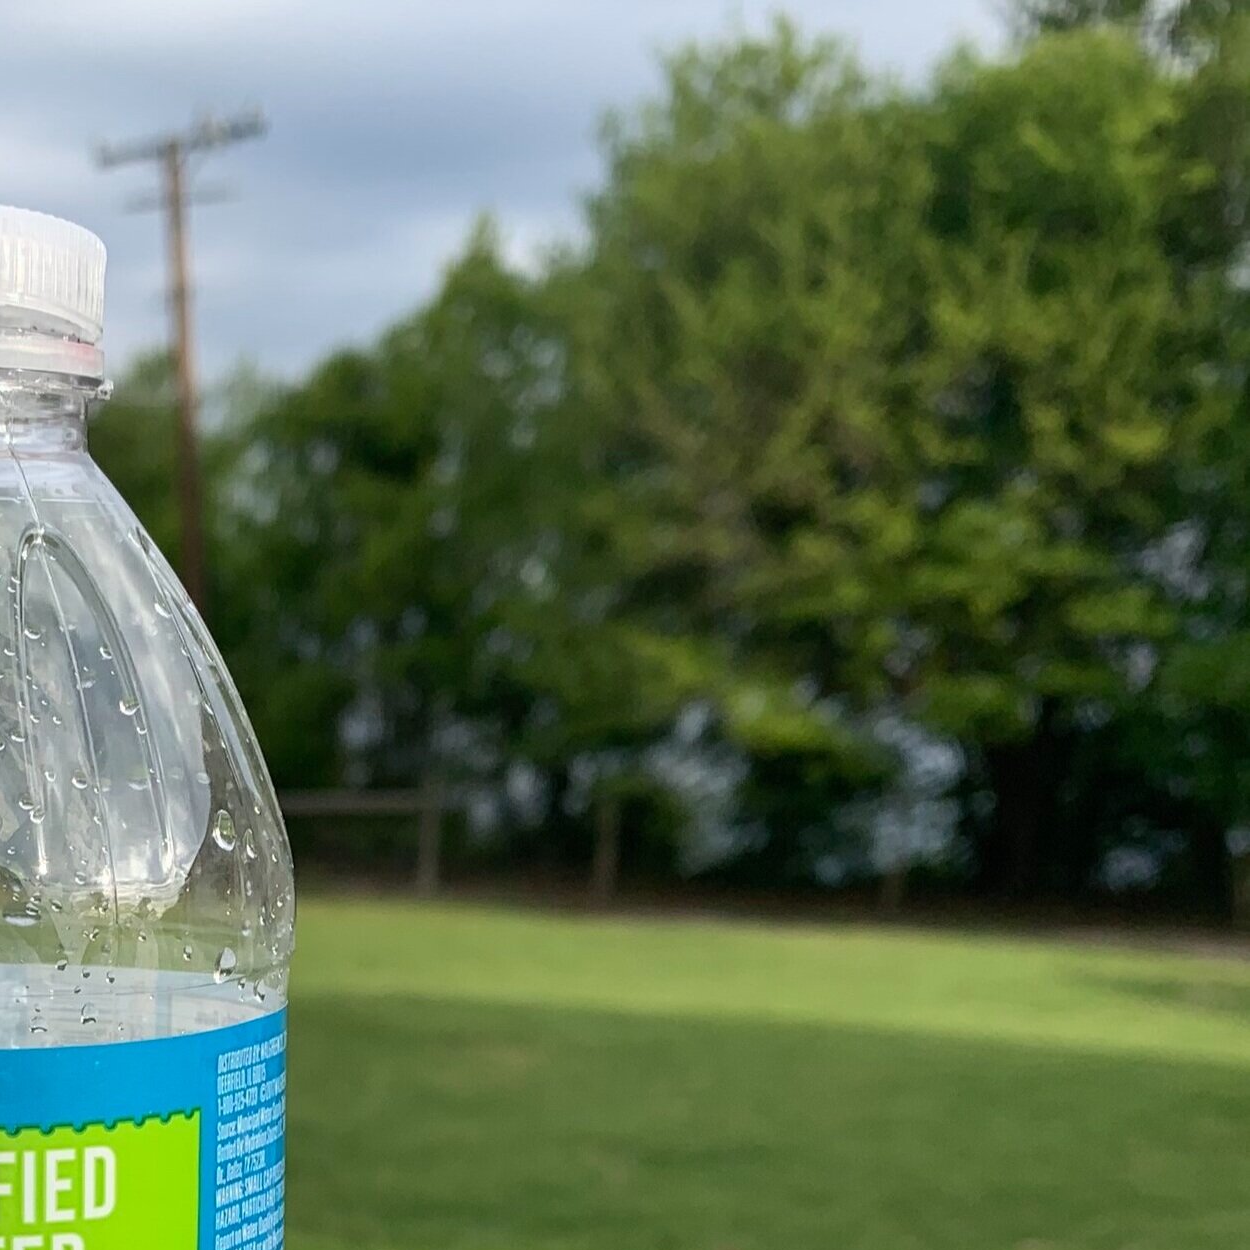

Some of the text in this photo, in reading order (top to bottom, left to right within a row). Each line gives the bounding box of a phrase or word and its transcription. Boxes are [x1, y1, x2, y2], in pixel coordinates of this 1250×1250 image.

[215, 1180, 245, 1209] WARNING:
[244, 1172, 263, 1196] SMALL
[215, 1204, 242, 1231] HAZARD,
